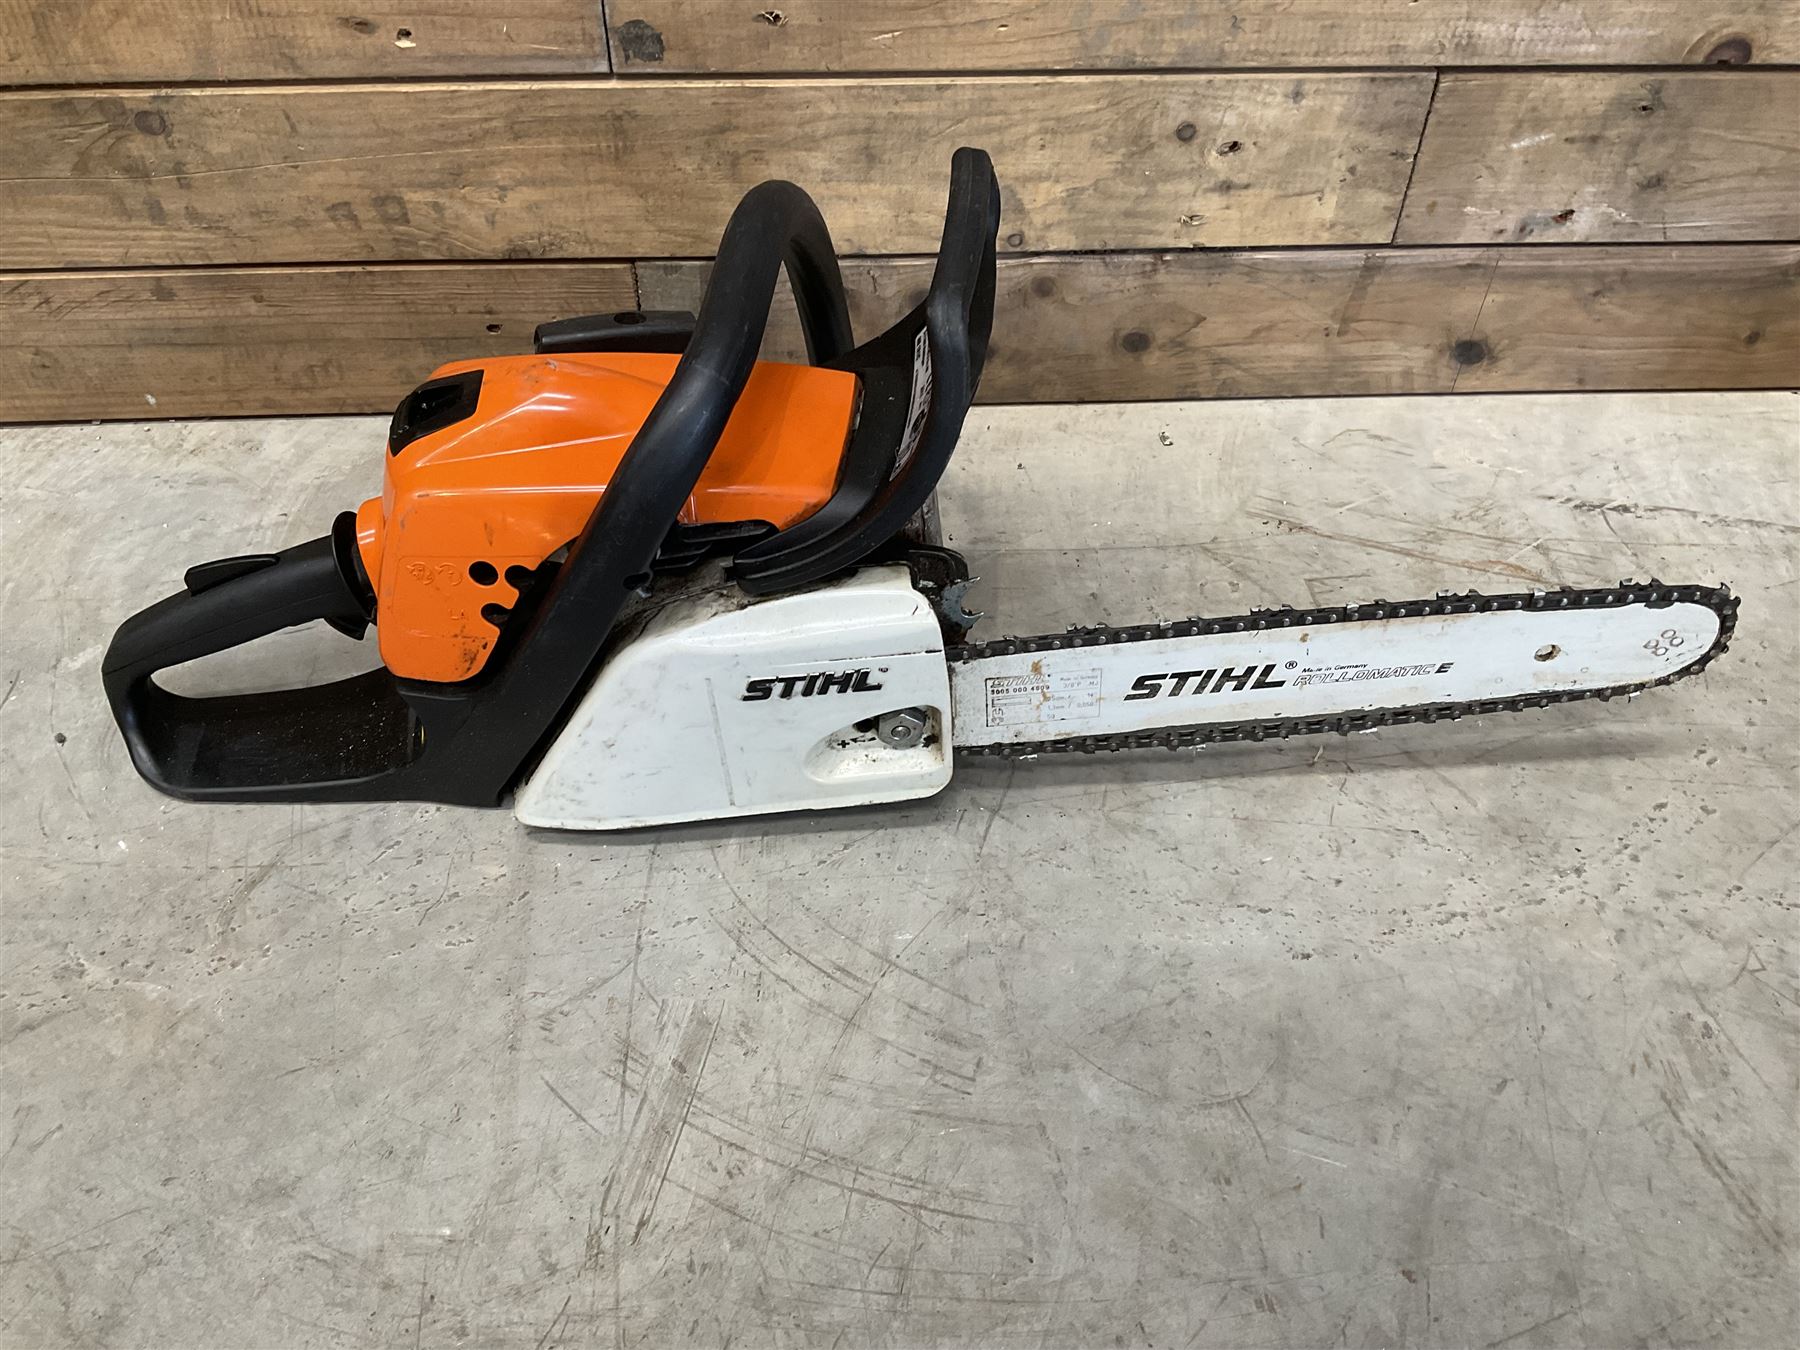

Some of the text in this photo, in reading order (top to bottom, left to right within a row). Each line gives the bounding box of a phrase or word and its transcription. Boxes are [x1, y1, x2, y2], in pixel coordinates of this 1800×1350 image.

[1292, 662, 1455, 687] ROLLOMATIC E
[1334, 663, 1369, 672] Germany
[742, 668, 883, 701] STIHL
[1012, 686, 1028, 694] 000
[1124, 663, 1287, 701] STIHL
